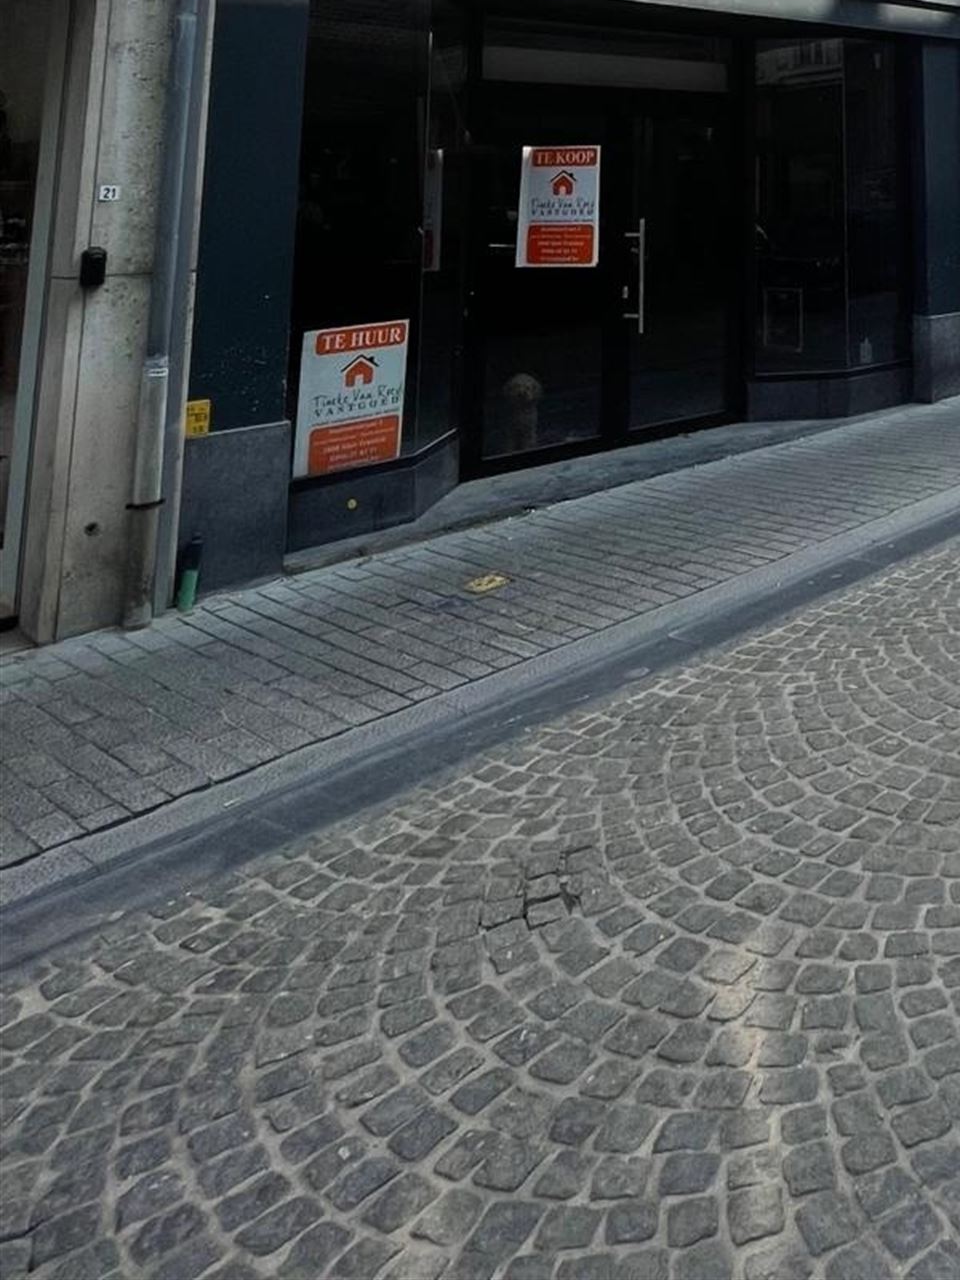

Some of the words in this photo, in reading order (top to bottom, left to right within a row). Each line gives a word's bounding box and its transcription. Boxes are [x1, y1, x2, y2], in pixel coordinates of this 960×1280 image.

[536, 152, 553, 165] TE
[556, 151, 595, 165] KOOP
[103, 187, 116, 199] 21
[322, 334, 346, 351] TE
[351, 327, 401, 347] HUUR
[314, 396, 400, 417] VASTGOED
